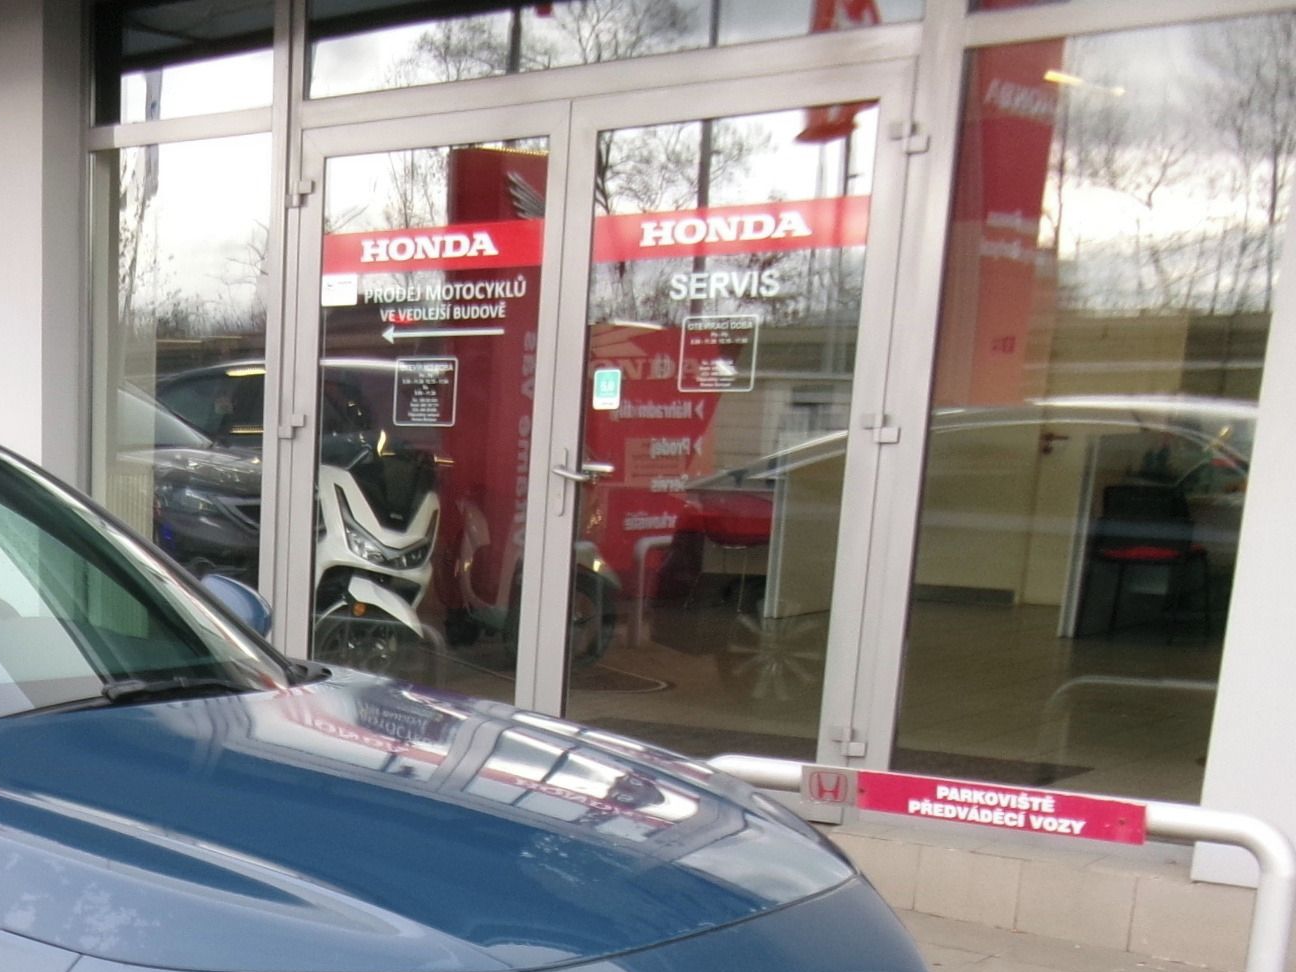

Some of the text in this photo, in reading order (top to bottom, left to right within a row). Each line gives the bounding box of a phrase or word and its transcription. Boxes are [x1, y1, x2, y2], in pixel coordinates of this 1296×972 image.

[640, 211, 812, 247] HONDA
[360, 231, 499, 263] HONDA
[364, 275, 527, 304] PRODEJ MOTOCYKLŮ
[669, 270, 780, 300] SERVIS
[380, 301, 506, 323] VE VEDLEJŠÍ BUDOVĚ
[936, 785, 1055, 813] PARKOVIŠTĚ
[908, 799, 1087, 835] PŘEDVÁDĚCÍ VOZY
